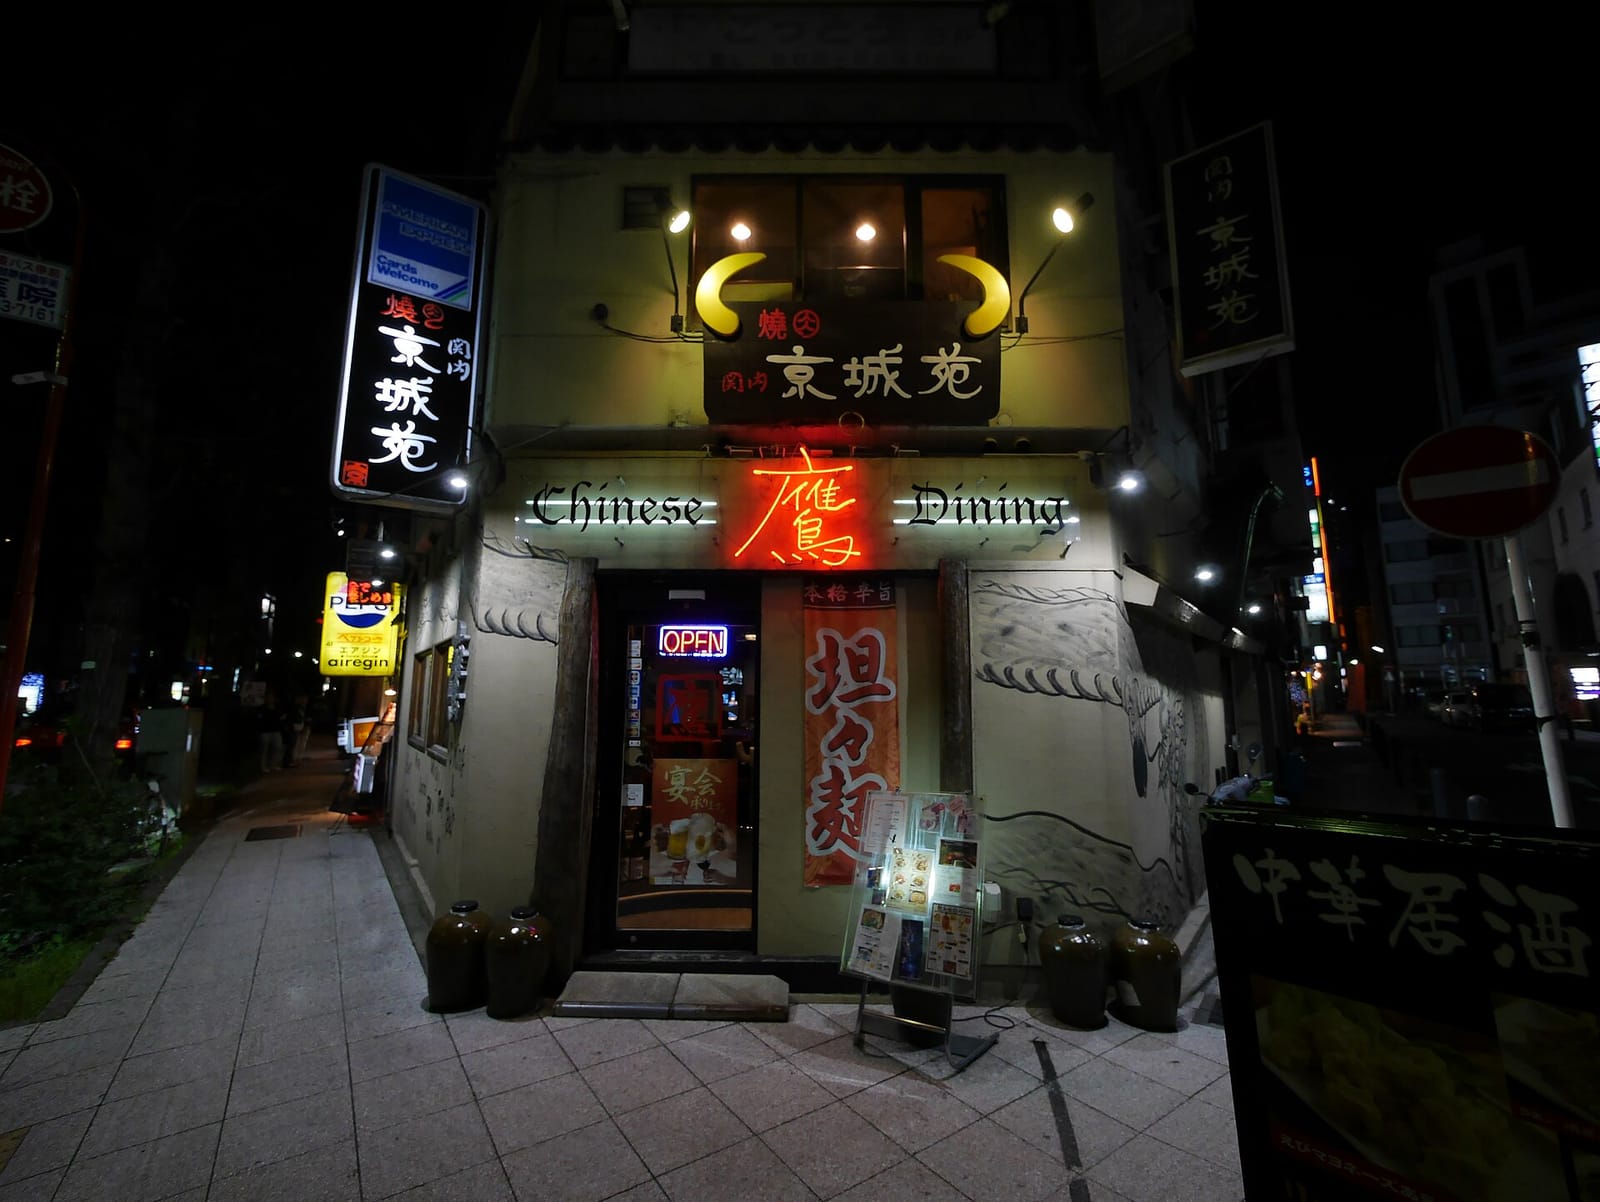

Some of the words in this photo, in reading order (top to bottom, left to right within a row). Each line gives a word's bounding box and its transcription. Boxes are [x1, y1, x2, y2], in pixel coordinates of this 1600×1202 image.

[0, 174, 40, 214] 栓
[376, 253, 418, 275] Cards
[376, 262, 439, 292] Welcome
[765, 341, 984, 401] 京城苑
[367, 323, 442, 474] 京城苑
[533, 480, 704, 533] Chinese
[908, 480, 1069, 536] Dining
[734, 447, 861, 567] 鷹
[803, 582, 891, 604] 本格辛旨
[663, 630, 724, 653] OPEN
[328, 655, 388, 671] airegin
[661, 764, 723, 806] 宴会
[1231, 847, 1593, 979] 中華居酒
